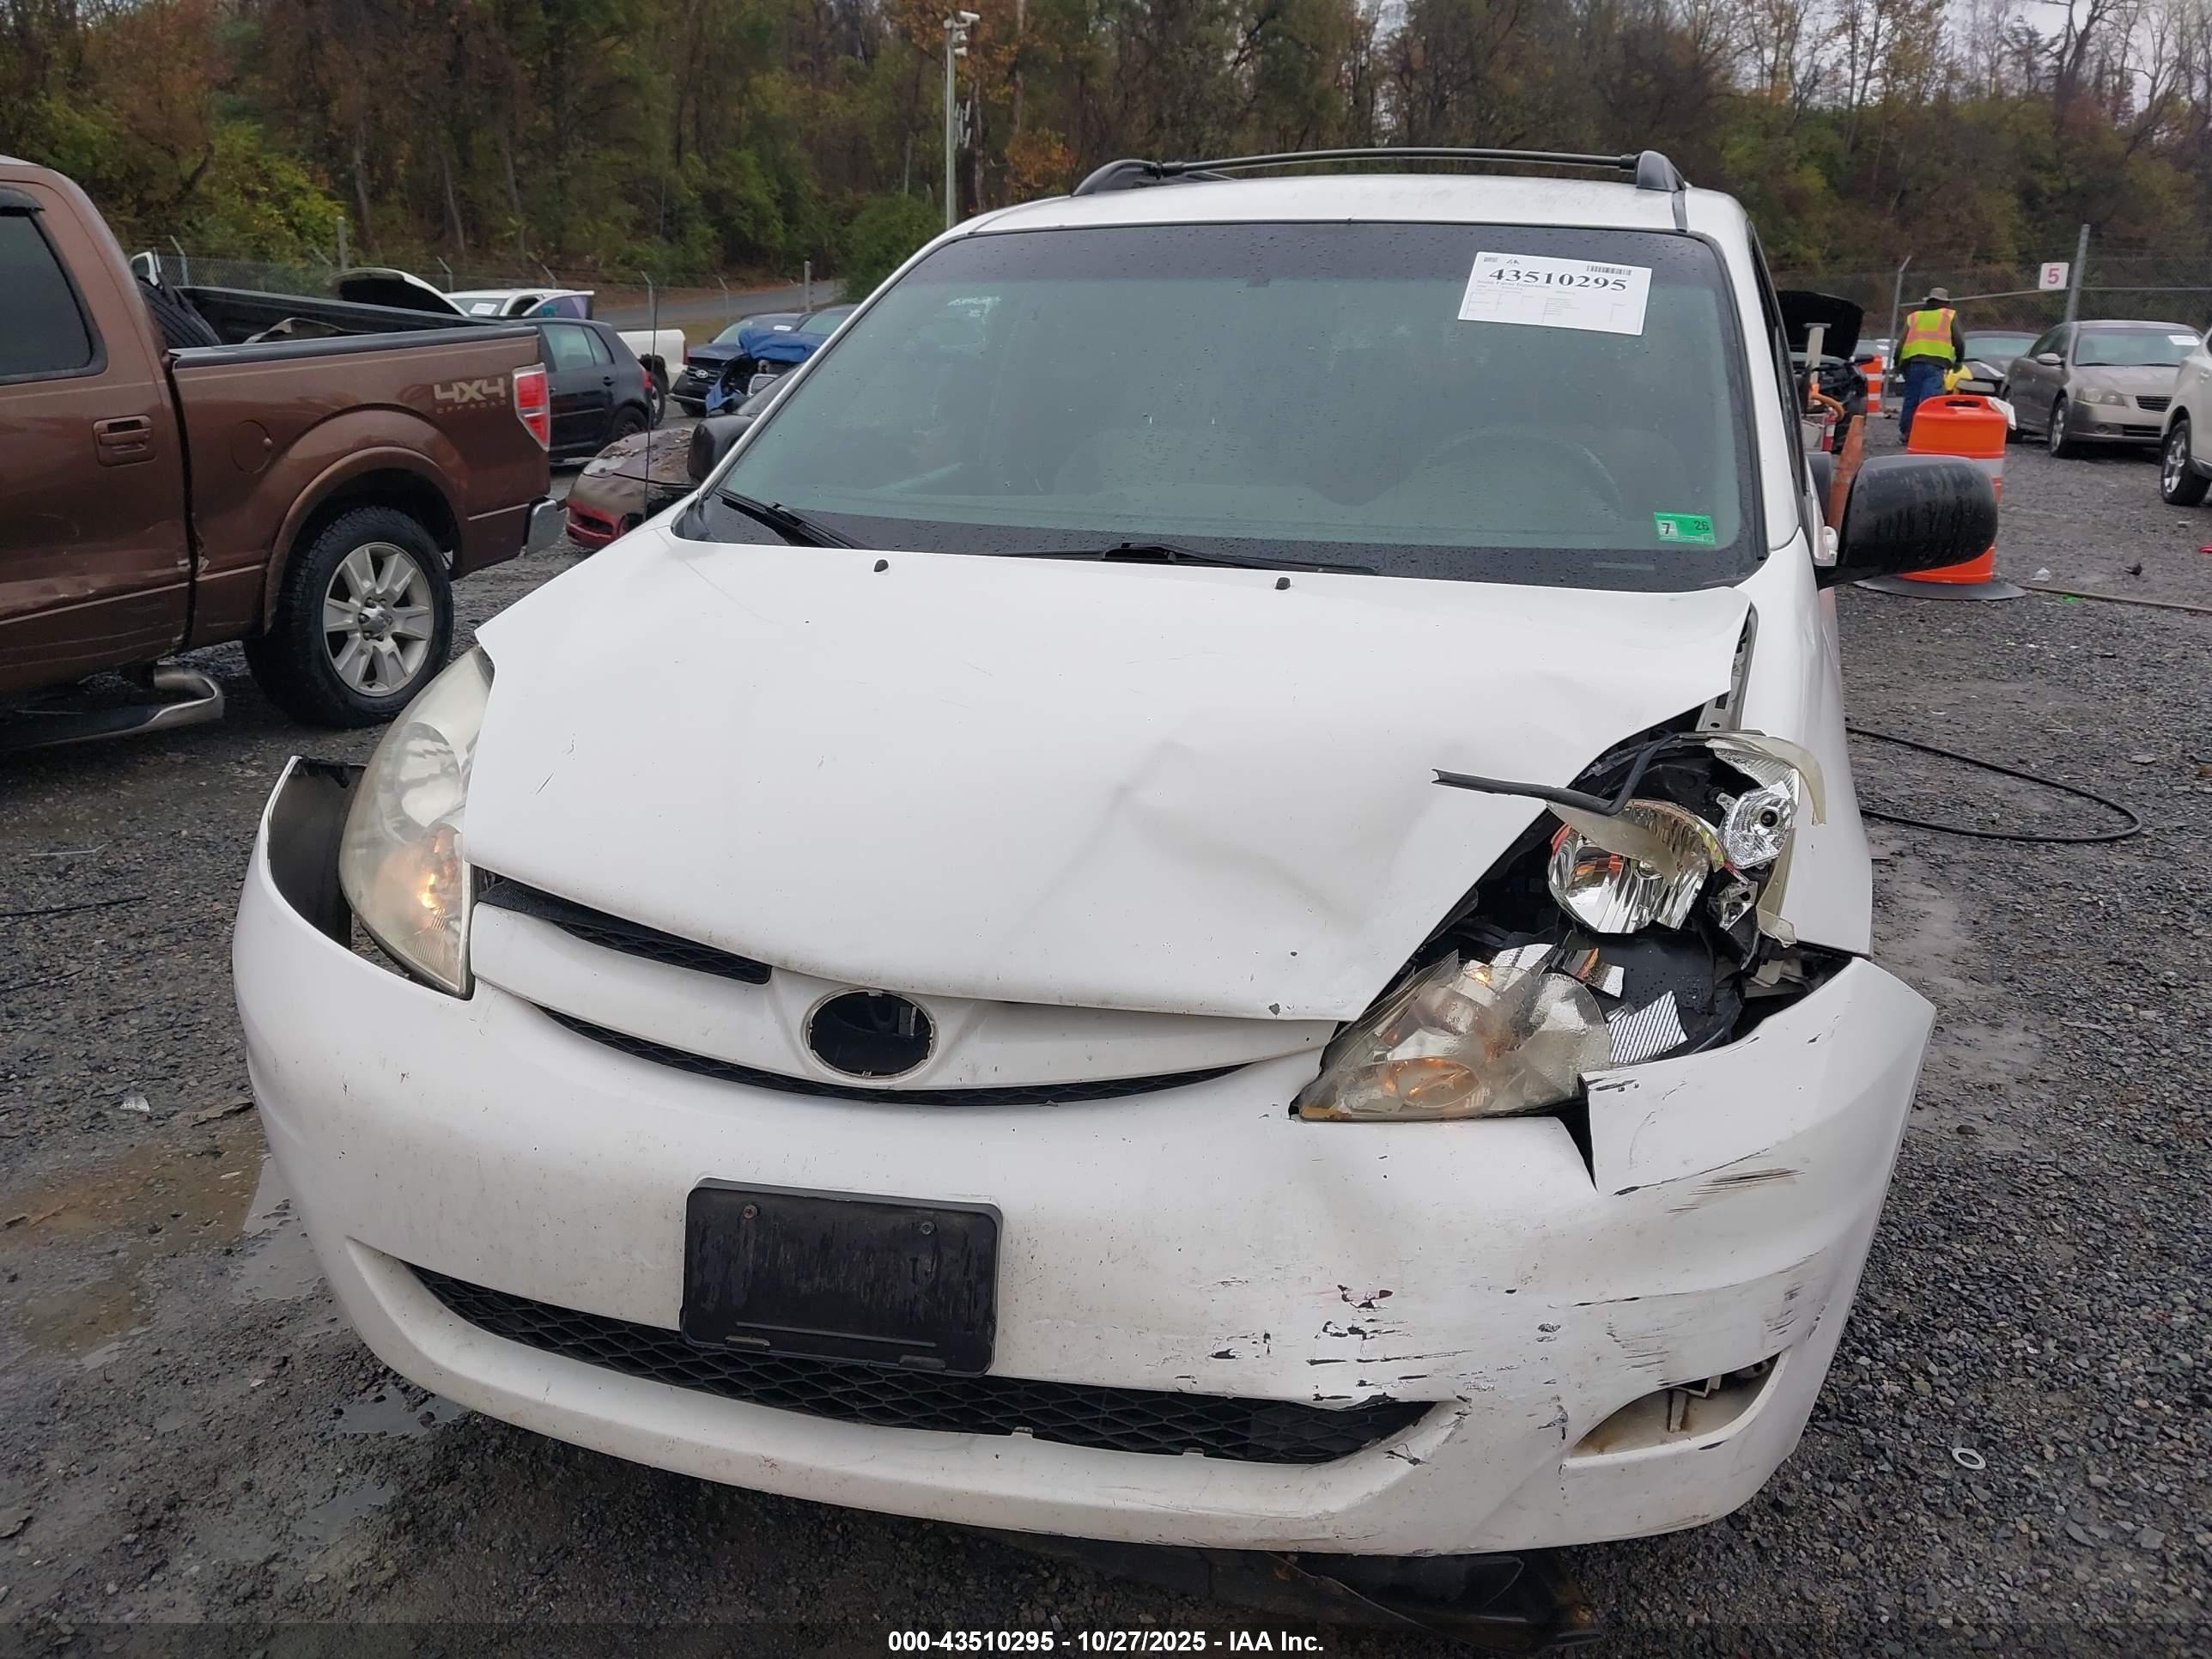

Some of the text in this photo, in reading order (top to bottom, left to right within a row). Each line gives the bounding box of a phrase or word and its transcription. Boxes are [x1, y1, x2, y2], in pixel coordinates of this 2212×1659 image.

[1488, 268, 1628, 292] 43510295
[2047, 267, 2060, 285] 5
[1662, 522, 1671, 535] 7
